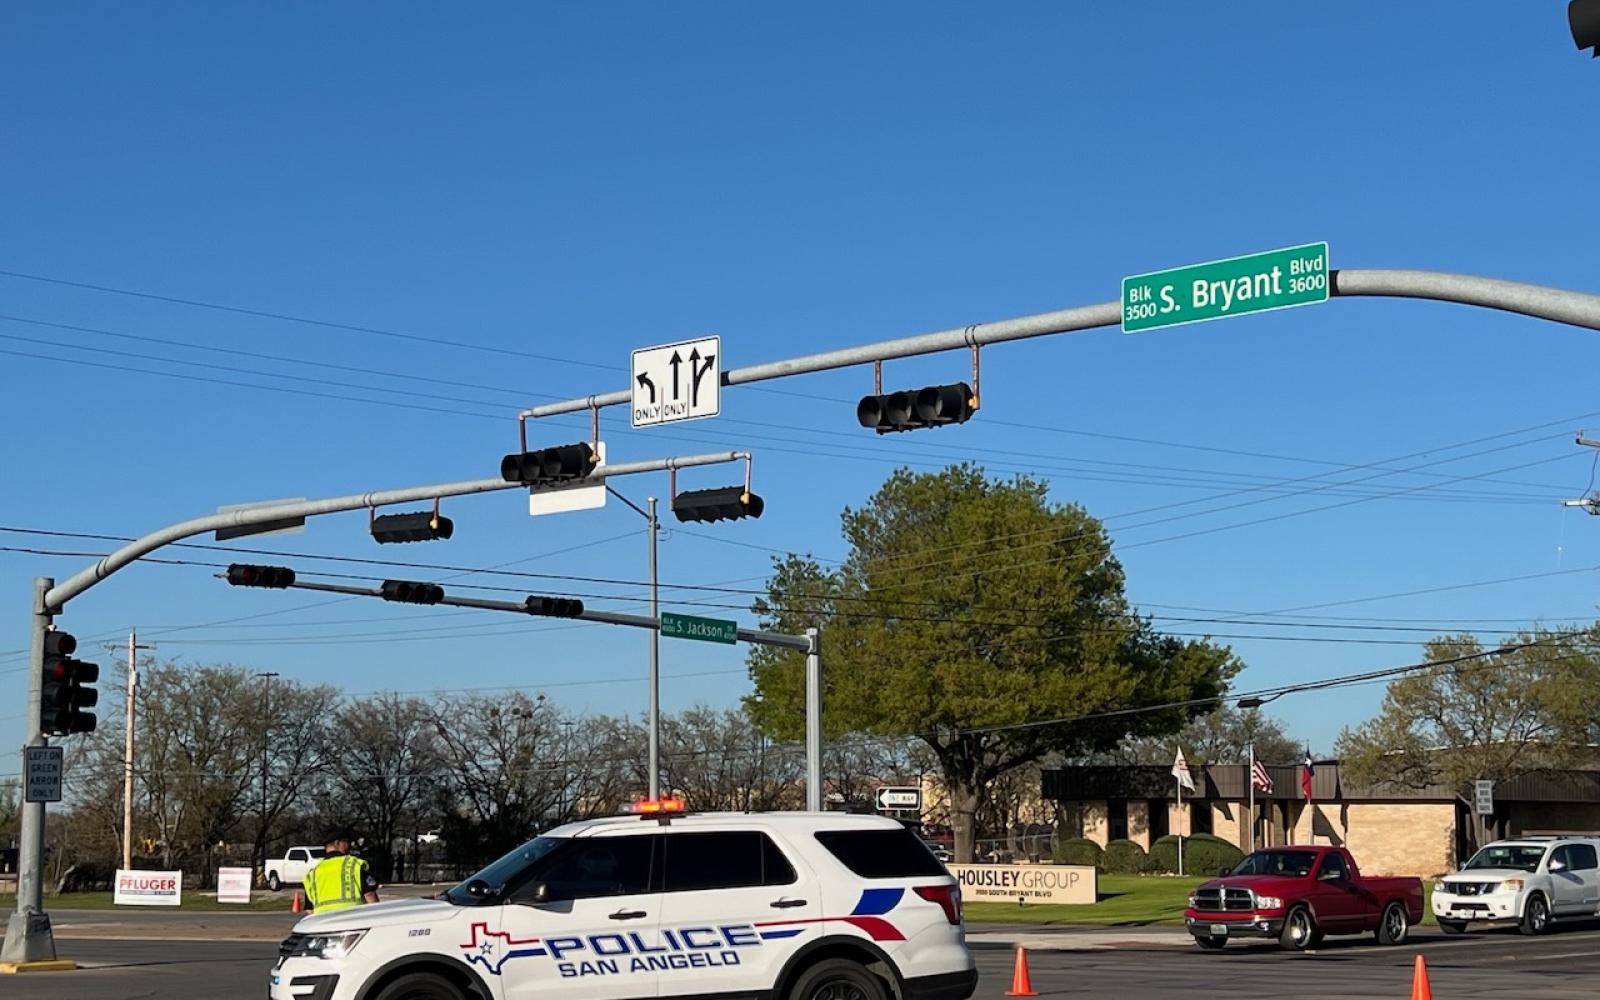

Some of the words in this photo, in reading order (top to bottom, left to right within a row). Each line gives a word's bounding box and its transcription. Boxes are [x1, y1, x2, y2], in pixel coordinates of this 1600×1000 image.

[1290, 255, 1323, 276] Blvd
[1159, 285, 1181, 314] S.
[1192, 266, 1282, 311] Bryant
[1288, 273, 1325, 294] 3600
[1129, 286, 1152, 303] Blk
[1125, 303, 1157, 321] 3500
[635, 405, 660, 421] ONLY
[663, 402, 687, 416] ONLY
[687, 622, 723, 638] Jackson
[29, 751, 47, 760] LEFT
[49, 751, 60, 760] ON
[31, 763, 58, 773] GREEN
[30, 776, 58, 785] ARROW
[120, 879, 176, 890] PFLUGER
[958, 869, 1020, 887] HOUSLEY
[1022, 870, 1080, 889] GROUP
[544, 924, 762, 960] POLICE
[558, 958, 620, 978] SAN
[630, 950, 741, 972] ANGELO
